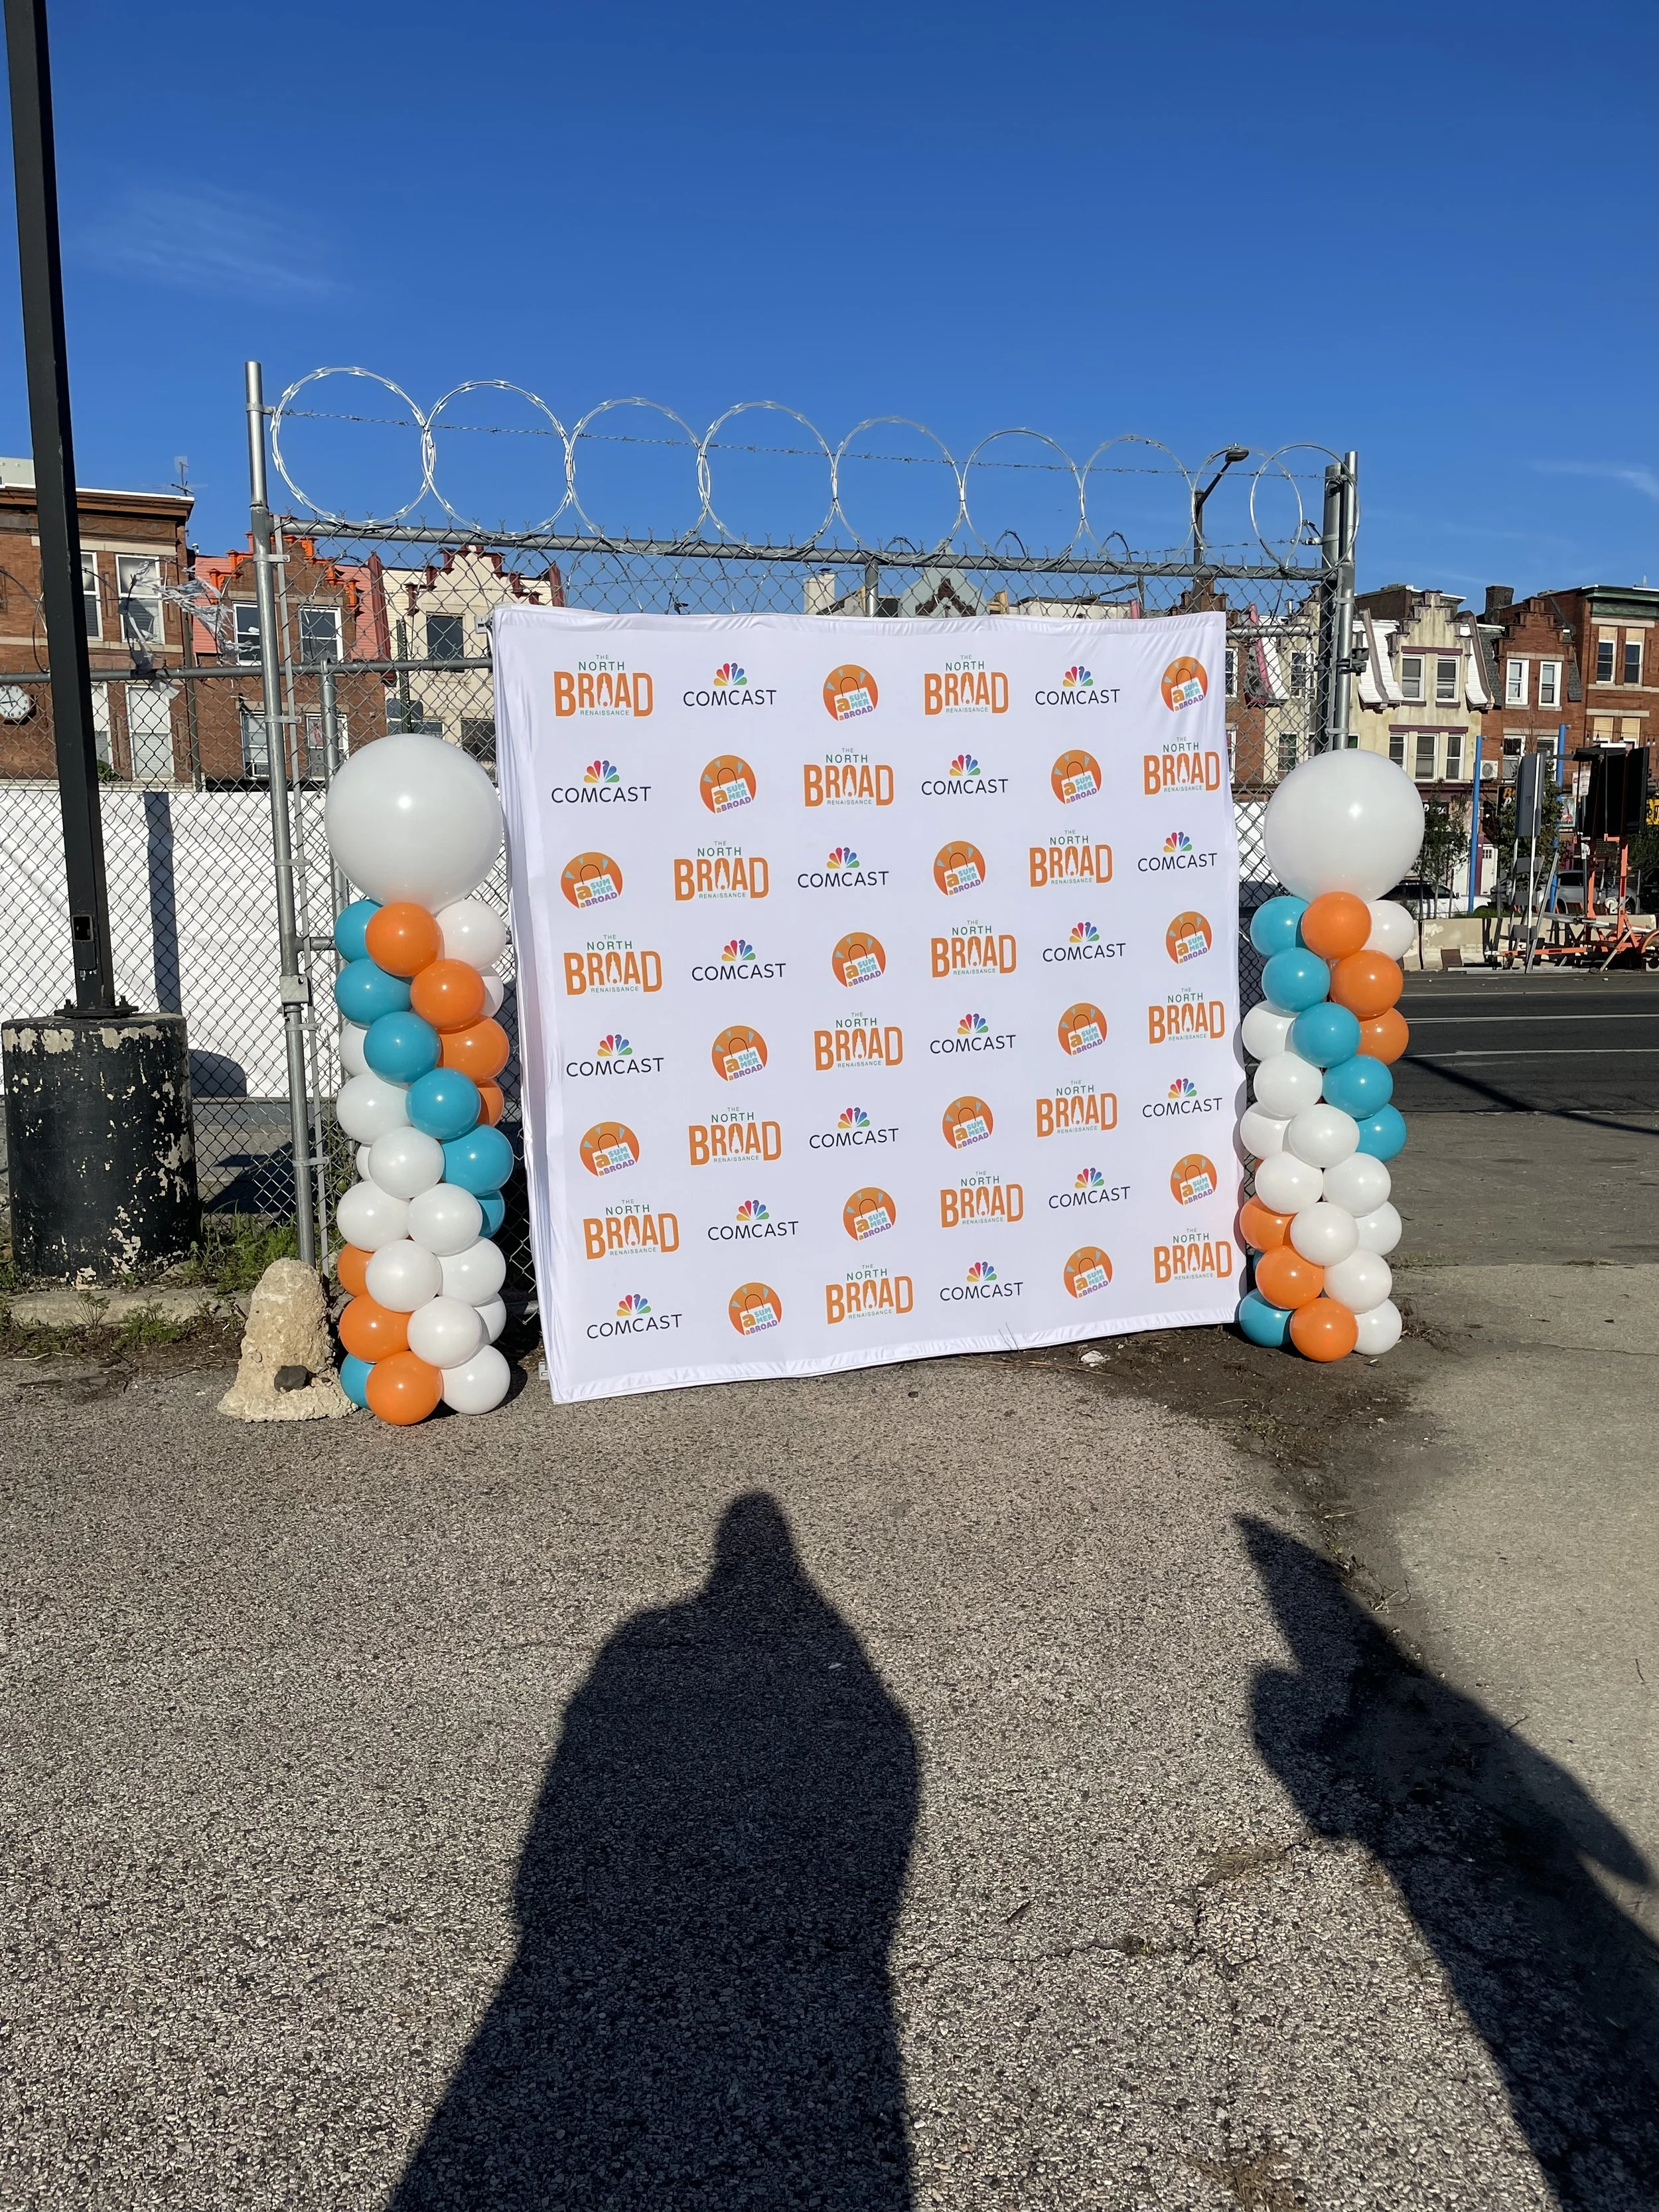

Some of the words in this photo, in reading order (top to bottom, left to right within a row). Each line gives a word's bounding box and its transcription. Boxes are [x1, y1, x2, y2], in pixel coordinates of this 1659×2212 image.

[579, 662, 624, 671] NORTH
[946, 661, 984, 671] NORTH
[1183, 682, 1199, 692] SUM
[554, 672, 653, 717] BROAD
[684, 690, 776, 706] COMCAST
[849, 692, 867, 701] SUM
[924, 672, 1008, 715] BROAD
[1036, 690, 1119, 705] COMCAST
[1185, 689, 1200, 698] MER
[851, 699, 869, 709] MER
[1163, 742, 1198, 753] NORTH
[826, 755, 867, 763] NORTH
[1144, 751, 1220, 794] BROAD
[804, 765, 894, 807] BROAD
[1075, 776, 1092, 785] SUM
[726, 782, 745, 793] SUM
[922, 779, 1008, 795] COMCAST
[1077, 782, 1094, 792] MER
[551, 786, 651, 802] COMCAST
[729, 790, 747, 801] MER
[1050, 836, 1088, 845] NORTH
[697, 847, 741, 857] NORTH
[1030, 844, 1112, 887] BROAD
[1138, 853, 1217, 871] COMCAST
[958, 867, 975, 877] SUM
[590, 879, 611, 889] SUM
[674, 857, 768, 901] BROAD
[798, 871, 889, 887] COMCAST
[960, 874, 977, 884] MER
[593, 887, 613, 897] MER
[952, 925, 991, 936] NORTH
[587, 941, 632, 950] NORTH
[1188, 936, 1203, 945] SUM
[1043, 943, 1125, 962] COMCAST
[1190, 942, 1205, 952] MER
[931, 934, 1016, 978] BROAD
[857, 958, 875, 968] SUM
[564, 951, 662, 995] BROAD
[692, 964, 786, 981] COMCAST
[860, 966, 878, 976] MER
[1168, 993, 1202, 1003] NORTH
[836, 1017, 877, 1028] NORTH
[1149, 1001, 1224, 1044] BROAD
[1081, 1027, 1098, 1036] SUM
[1083, 1033, 1100, 1043] MER
[814, 1027, 903, 1070] BROAD
[930, 1035, 1016, 1053] COMCAST
[738, 1051, 757, 1061] SUM
[567, 1058, 664, 1076] COMCAST
[741, 1058, 758, 1069] MER
[1056, 1084, 1094, 1096] NORTH
[1143, 1098, 1222, 1117] COMCAST
[711, 1112, 754, 1123] NORTH
[1037, 1093, 1117, 1137] BROAD
[967, 1120, 983, 1130] SUM
[969, 1127, 985, 1137] MER
[689, 1121, 781, 1165] BROAD
[810, 1128, 899, 1148] COMCAST
[609, 1147, 628, 1157] SUM
[611, 1153, 630, 1163] MER
[961, 1175, 999, 1187] NORTH
[1192, 1177, 1208, 1187] SUM
[1194, 1183, 1210, 1192] MER
[1049, 1186, 1130, 1209] COMCAST
[606, 1204, 650, 1215] NORTH
[940, 1184, 1023, 1228] BROAD
[869, 1211, 886, 1221] SUM
[871, 1218, 888, 1228] MER
[583, 1213, 680, 1259] BROAD
[708, 1221, 798, 1240] COMCAST
[1173, 1232, 1210, 1244] NORTH
[610, 1247, 656, 1256] RENAISSANCE
[1154, 1240, 1231, 1284] BROAD
[846, 1268, 887, 1280] NORTH
[1087, 1269, 1103, 1278] SUM
[1089, 1276, 1105, 1286] MER
[940, 1282, 1023, 1301] COMCAST
[826, 1276, 913, 1324] BROAD
[754, 1307, 772, 1317] SUM
[848, 1309, 893, 1319] RENAISSANCE
[756, 1314, 774, 1323] MER
[587, 1314, 682, 1339] COMCAST
